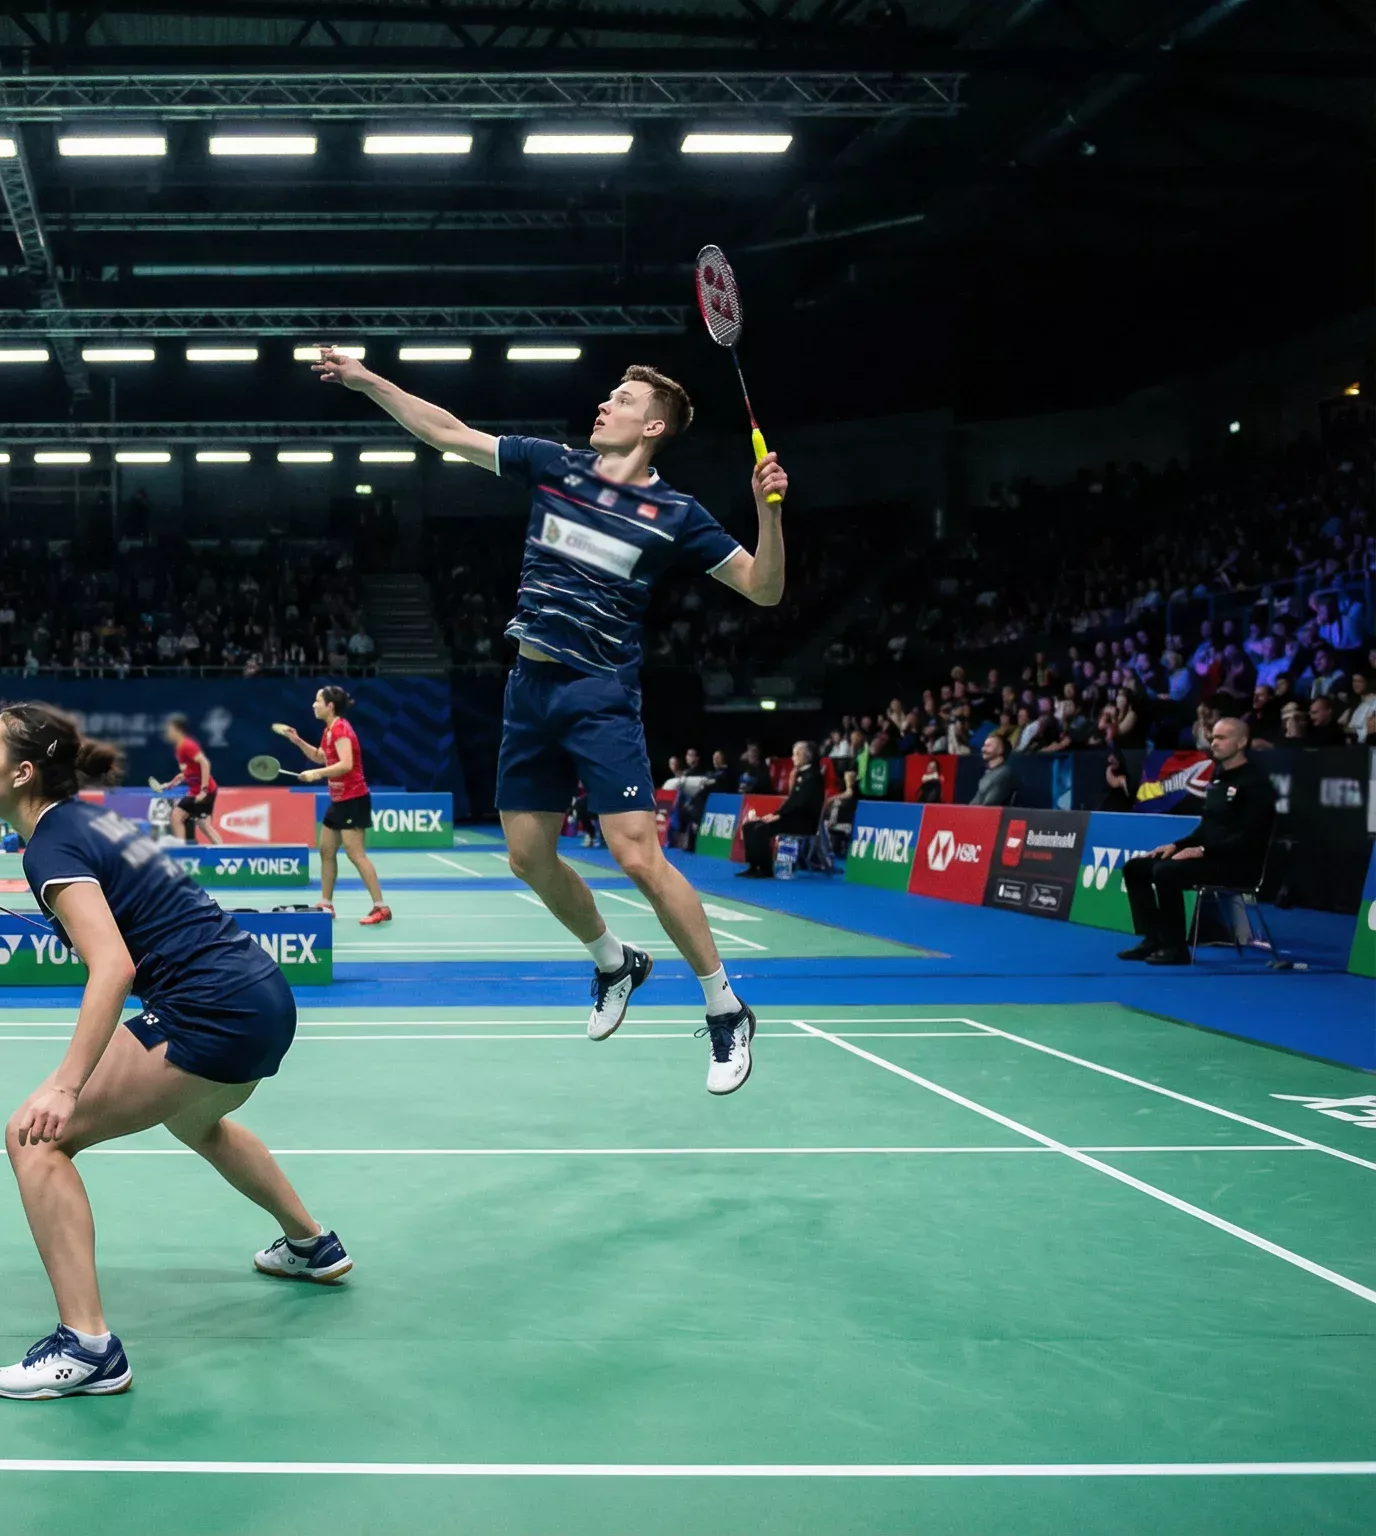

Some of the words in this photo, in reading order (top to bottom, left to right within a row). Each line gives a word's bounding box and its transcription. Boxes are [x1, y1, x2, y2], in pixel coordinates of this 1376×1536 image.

[370, 809, 443, 832] YONEX
[873, 827, 913, 863] YONEX
[955, 843, 981, 862] HSBC
[248, 858, 300, 875] YONEX
[251, 934, 317, 964] NEX
